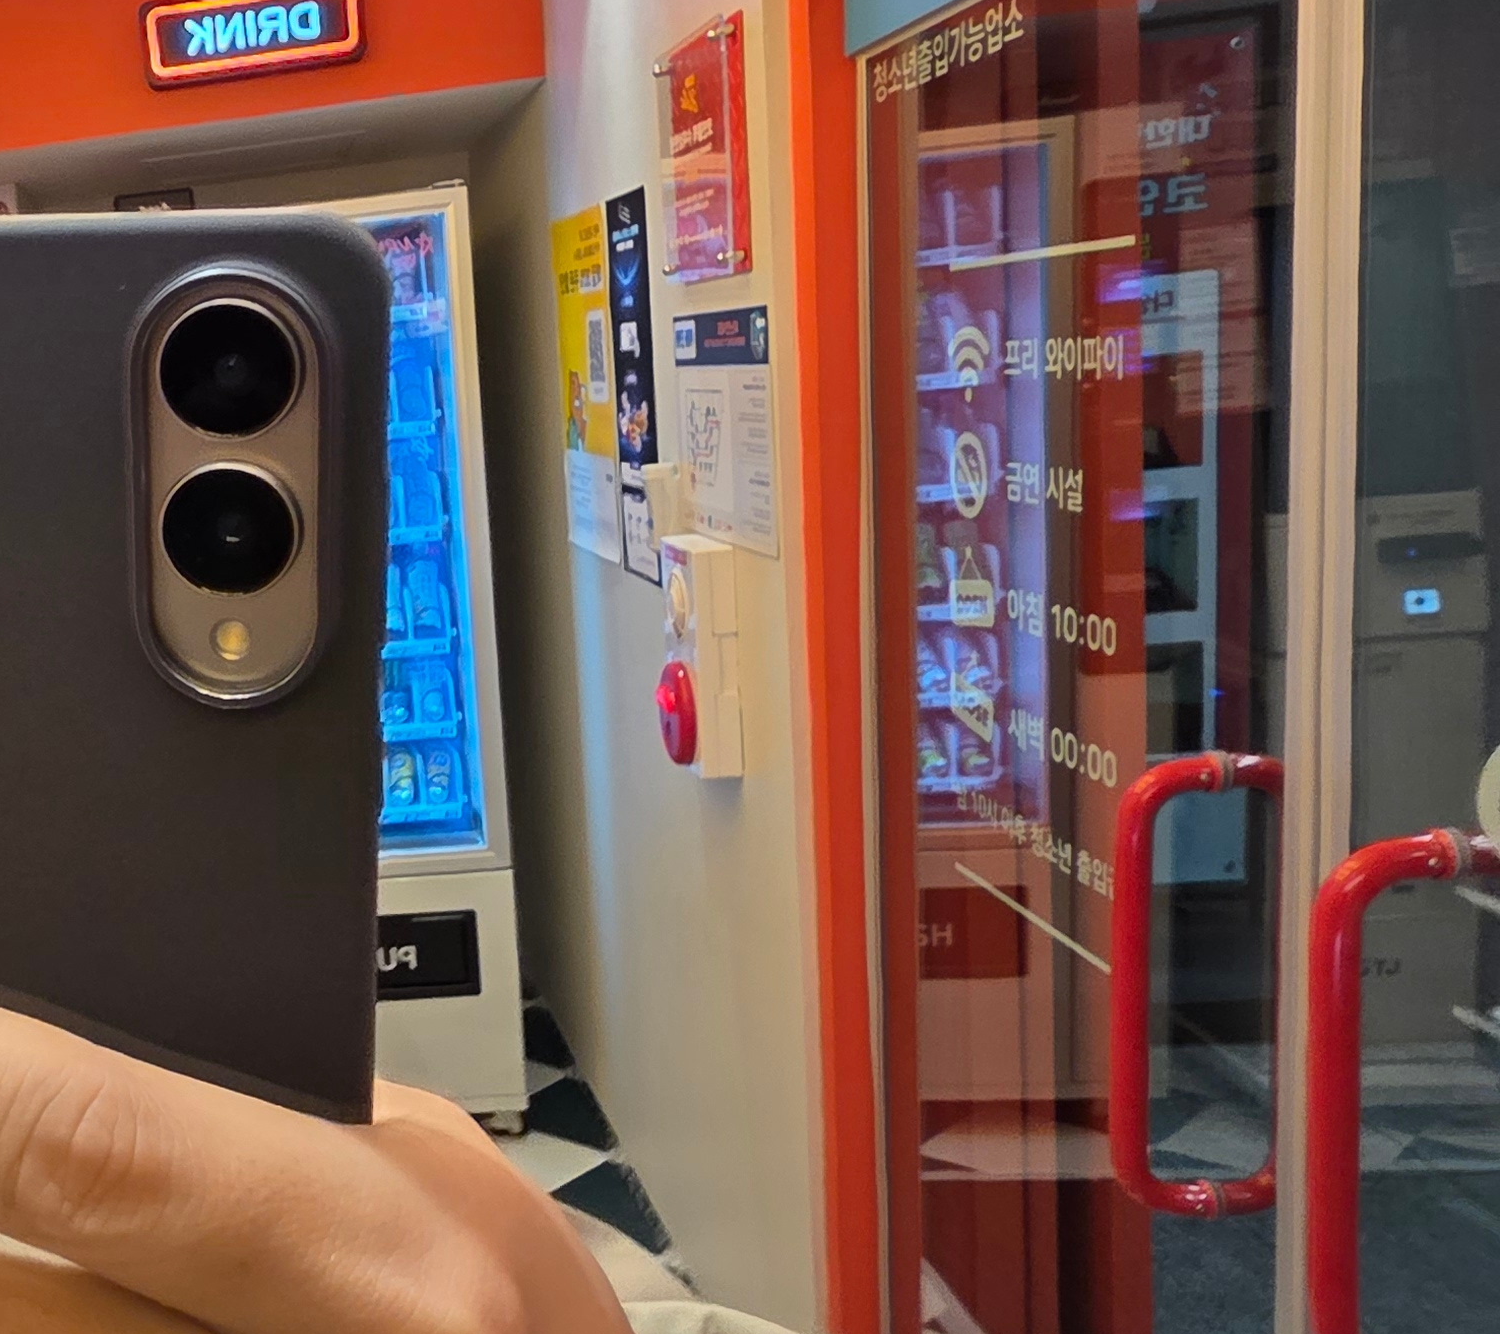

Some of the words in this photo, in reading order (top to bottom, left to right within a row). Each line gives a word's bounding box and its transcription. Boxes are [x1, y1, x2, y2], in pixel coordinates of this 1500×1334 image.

[873, 0, 1025, 104] 청소년출입가능업소
[1004, 338, 1039, 375] 프리
[1045, 333, 1125, 381] 와이파이
[1005, 461, 1041, 505] 금연
[1045, 467, 1084, 514] 시설
[1006, 588, 1044, 639] 아침
[1051, 603, 1118, 658] 10:00
[1006, 708, 1045, 763] 새벽
[1050, 725, 1119, 788] 00:00
[1030, 823, 1073, 875] 청소년
